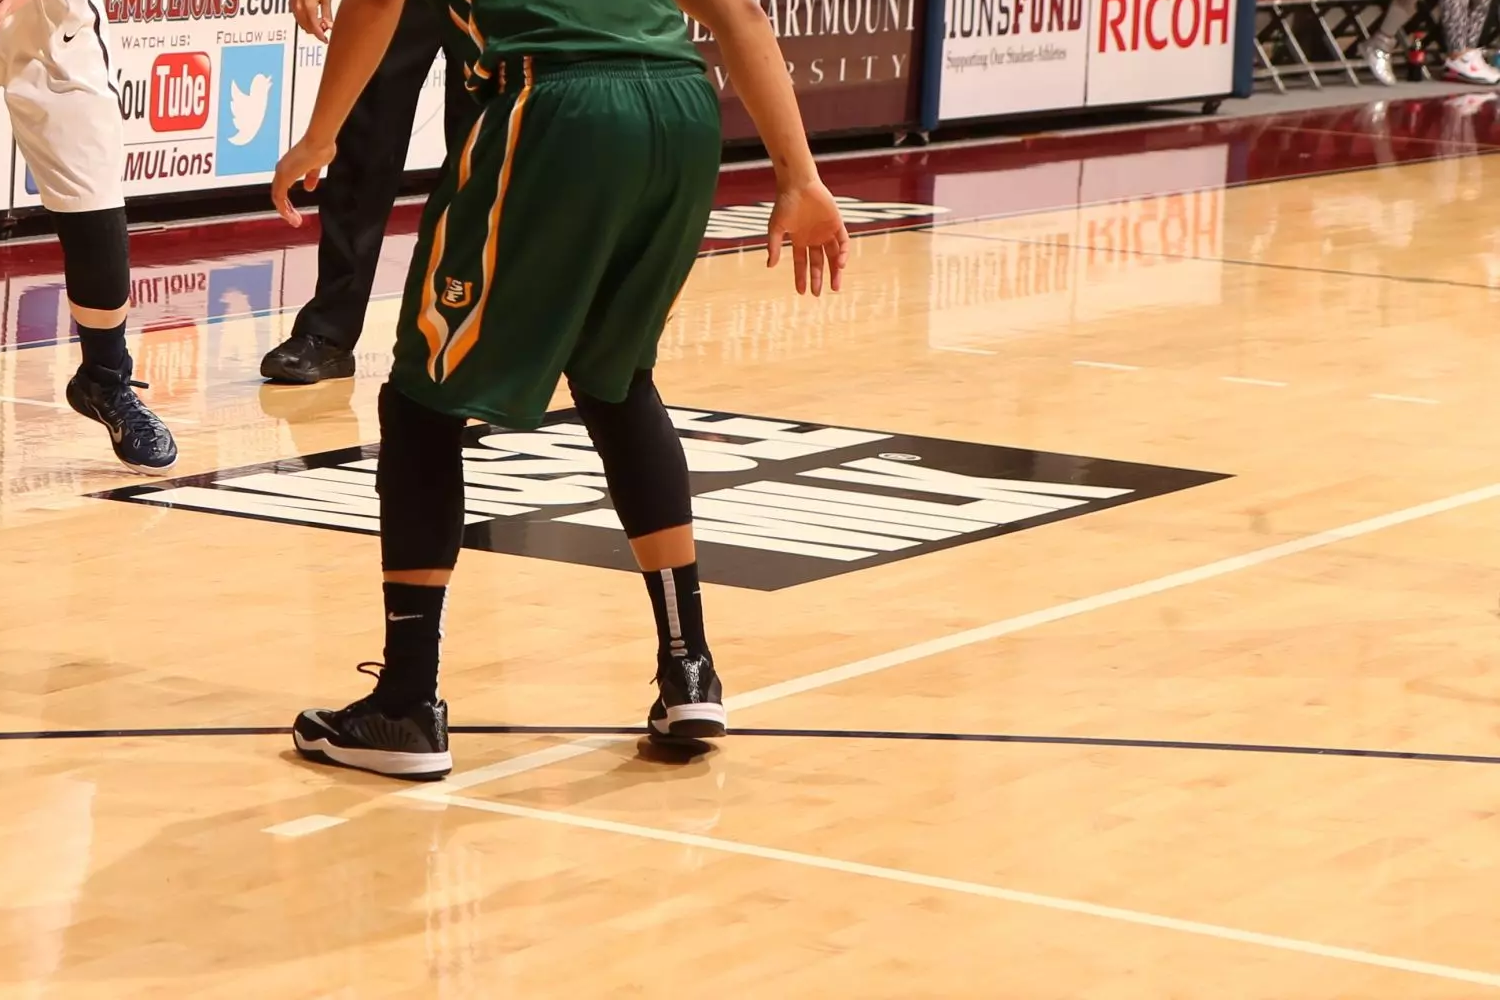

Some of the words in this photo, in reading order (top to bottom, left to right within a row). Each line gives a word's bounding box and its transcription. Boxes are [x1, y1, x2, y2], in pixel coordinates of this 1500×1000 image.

[299, 46, 322, 67] THE
[121, 147, 213, 183] MULions
[550, 456, 1137, 563] MILK
